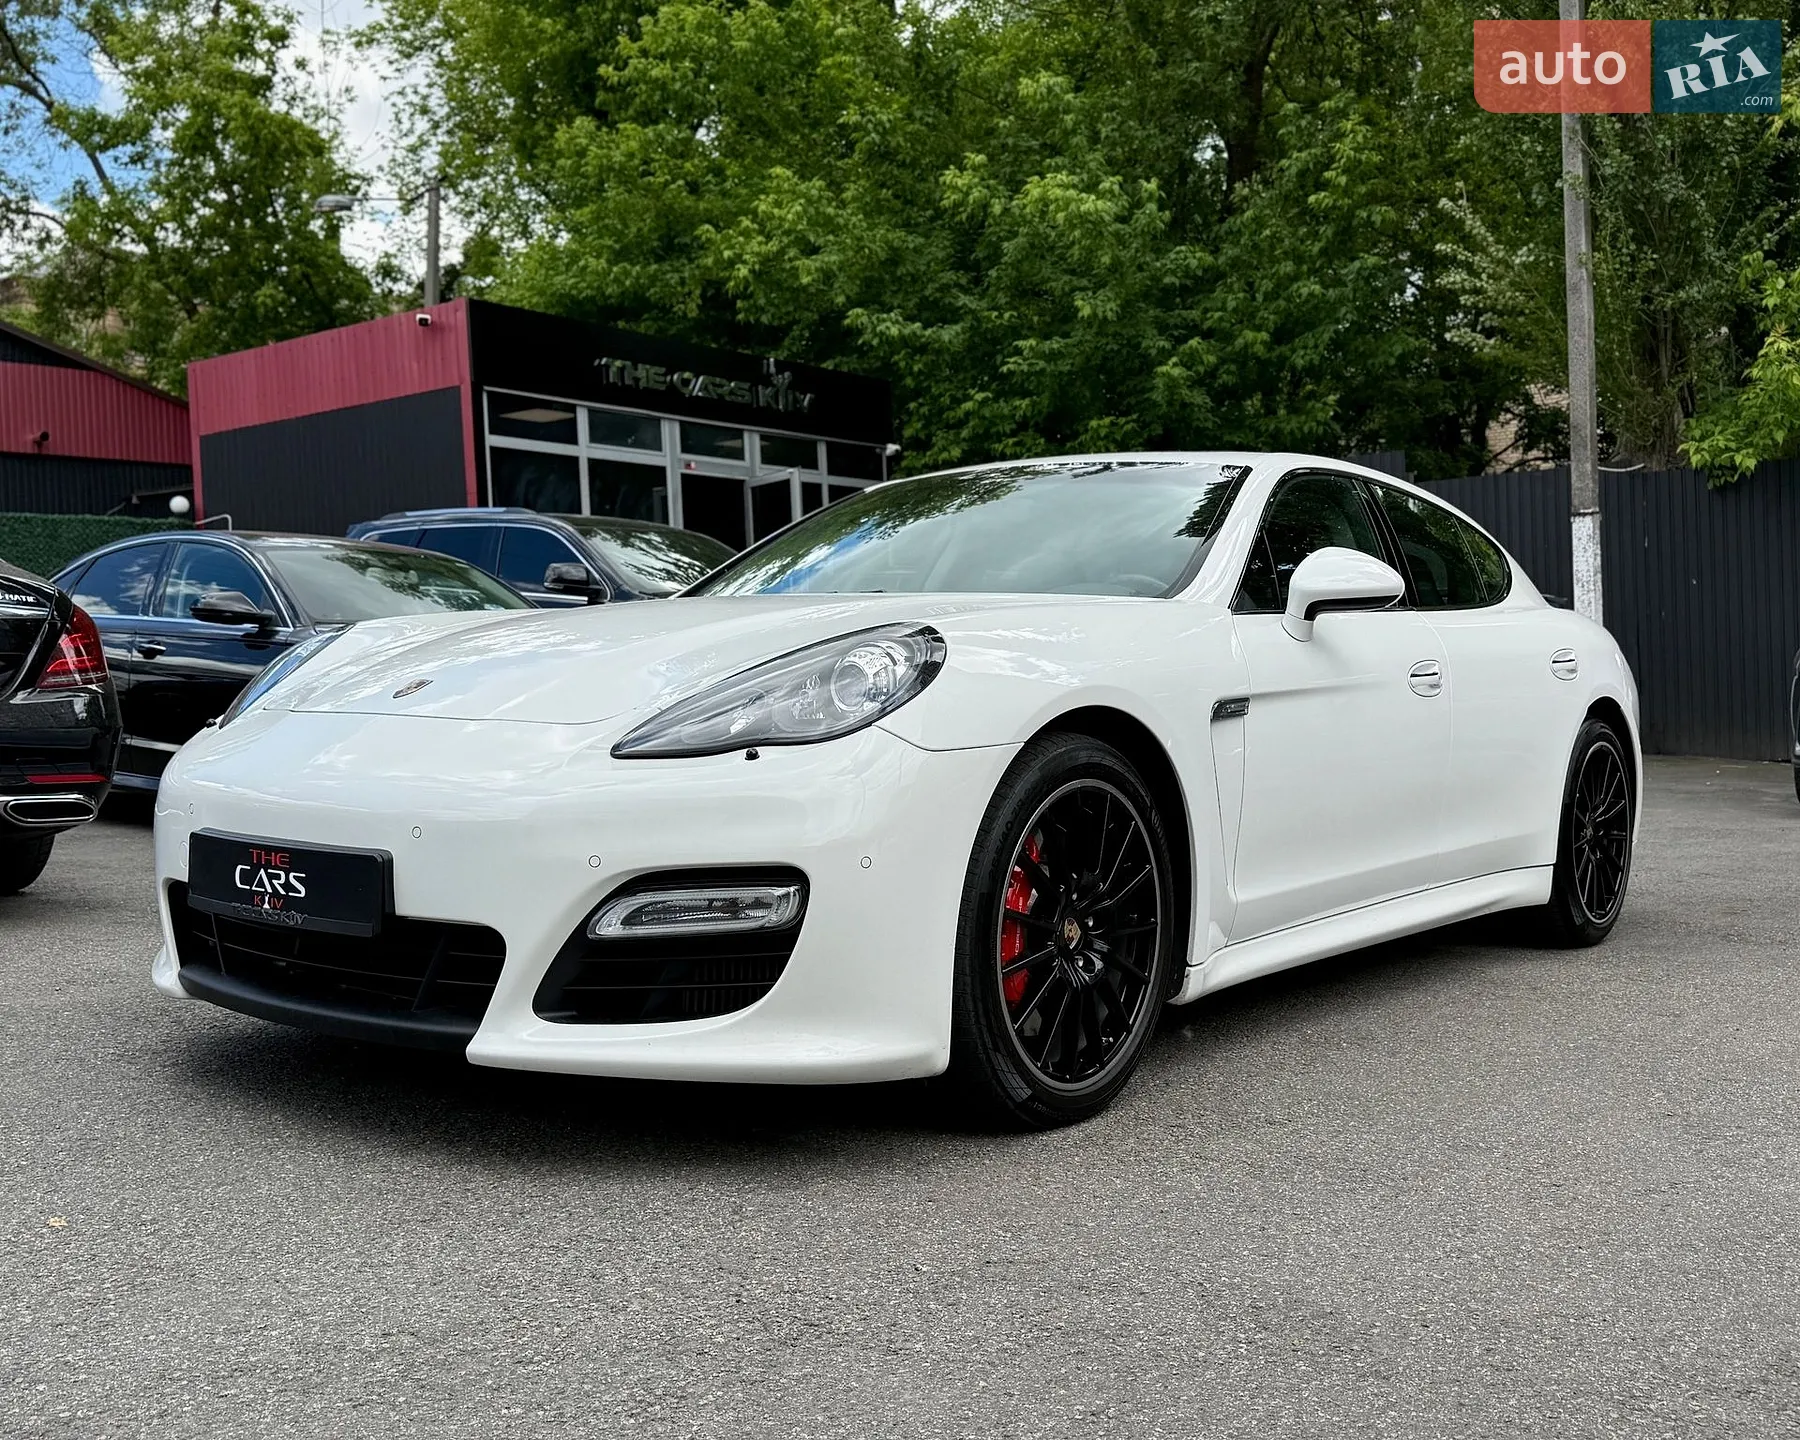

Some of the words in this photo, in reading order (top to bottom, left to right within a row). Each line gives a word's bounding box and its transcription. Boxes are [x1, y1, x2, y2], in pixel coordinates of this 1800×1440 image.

[597, 357, 667, 390] THE
[670, 371, 751, 403] CARS
[249, 849, 290, 868] THE
[235, 865, 306, 897] CARS
